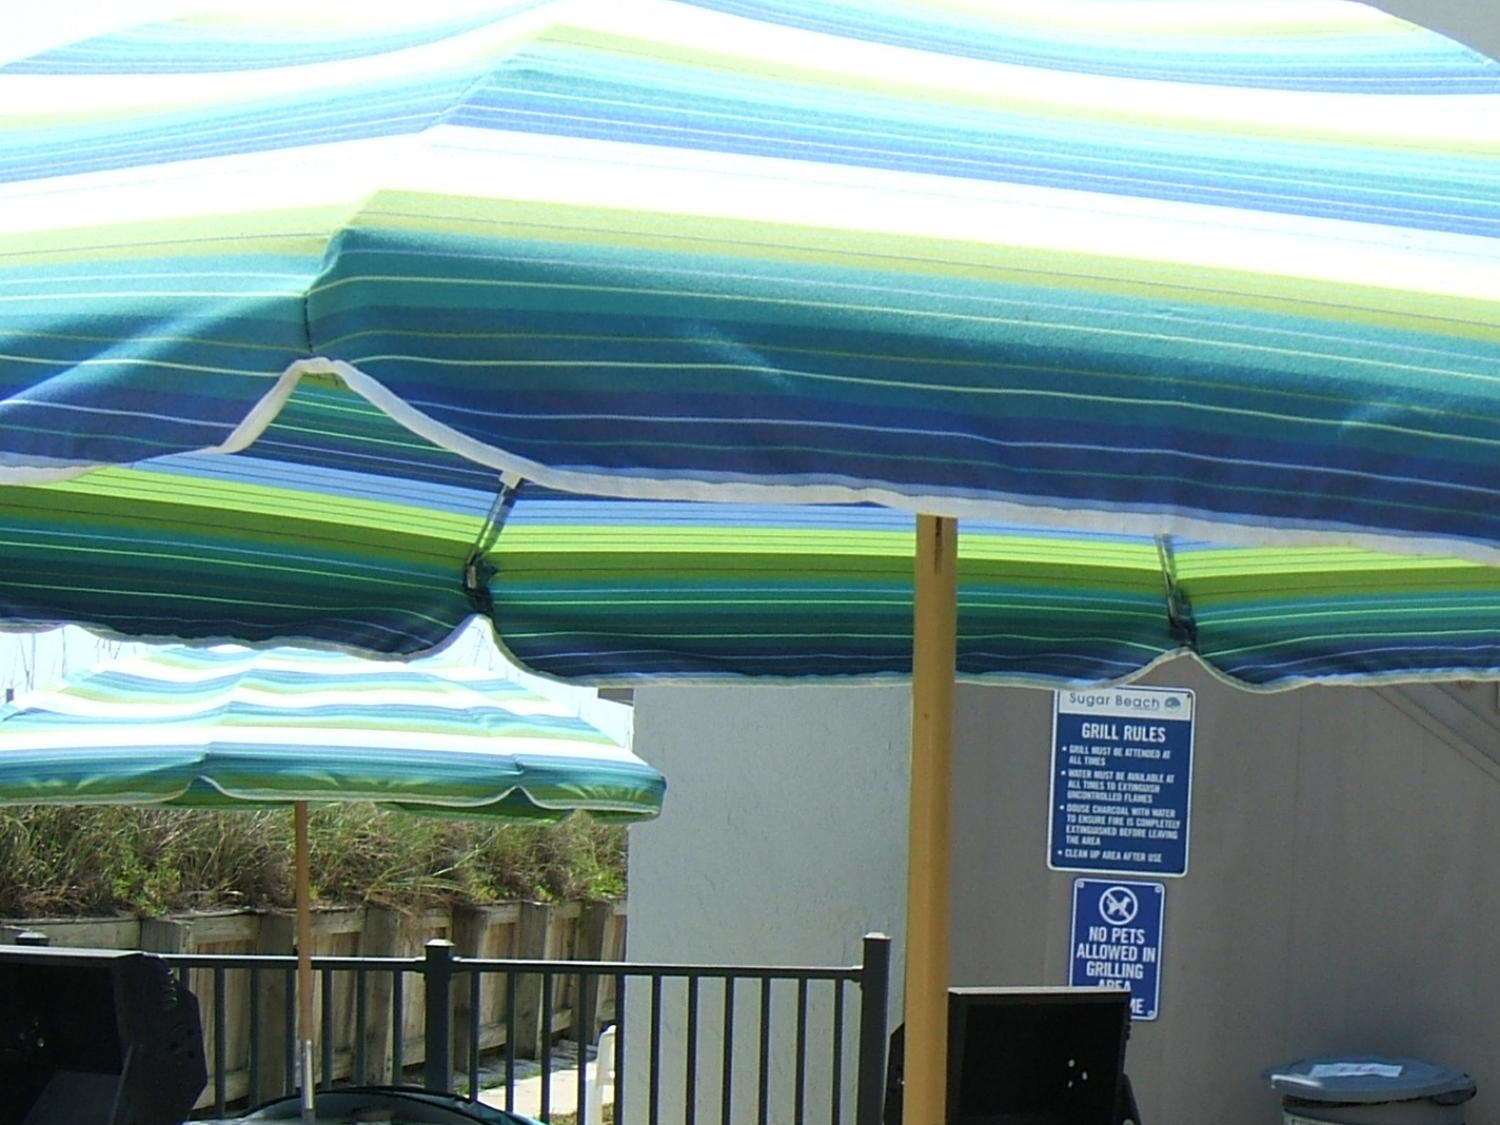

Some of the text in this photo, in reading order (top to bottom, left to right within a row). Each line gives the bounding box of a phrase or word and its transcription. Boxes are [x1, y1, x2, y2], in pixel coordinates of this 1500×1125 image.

[1068, 692, 1159, 709] Sugar Beach
[1081, 722, 1166, 742] GRILL RULES
[1069, 744, 1171, 759] GRILL MUST BE ATTENDED AT
[1069, 755, 1106, 766] ALL TIMES
[1068, 769, 1175, 783] WATER MUST BE AVAILABLE AT
[1068, 779, 1160, 793] ALL TIMES TO EXTINGUISH
[1067, 790, 1153, 804] UNCONTROLLED FLAMES
[1092, 804, 1129, 816] CHARCOAL
[1131, 807, 1150, 816] WITH
[1152, 808, 1176, 818] WATER
[1067, 814, 1180, 829] TO ENSURE FIRE IS COMPLETELY
[1066, 824, 1179, 840] EXTINGUISHED BEFORE LEAVING
[1066, 835, 1101, 846] THE AREA
[1065, 848, 1162, 863] CLEAN UP AREA AFTER USE
[1089, 926, 1145, 945] NO PETS
[1076, 942, 1156, 963] ALLOWED IN
[1086, 960, 1144, 979] GRILLING
